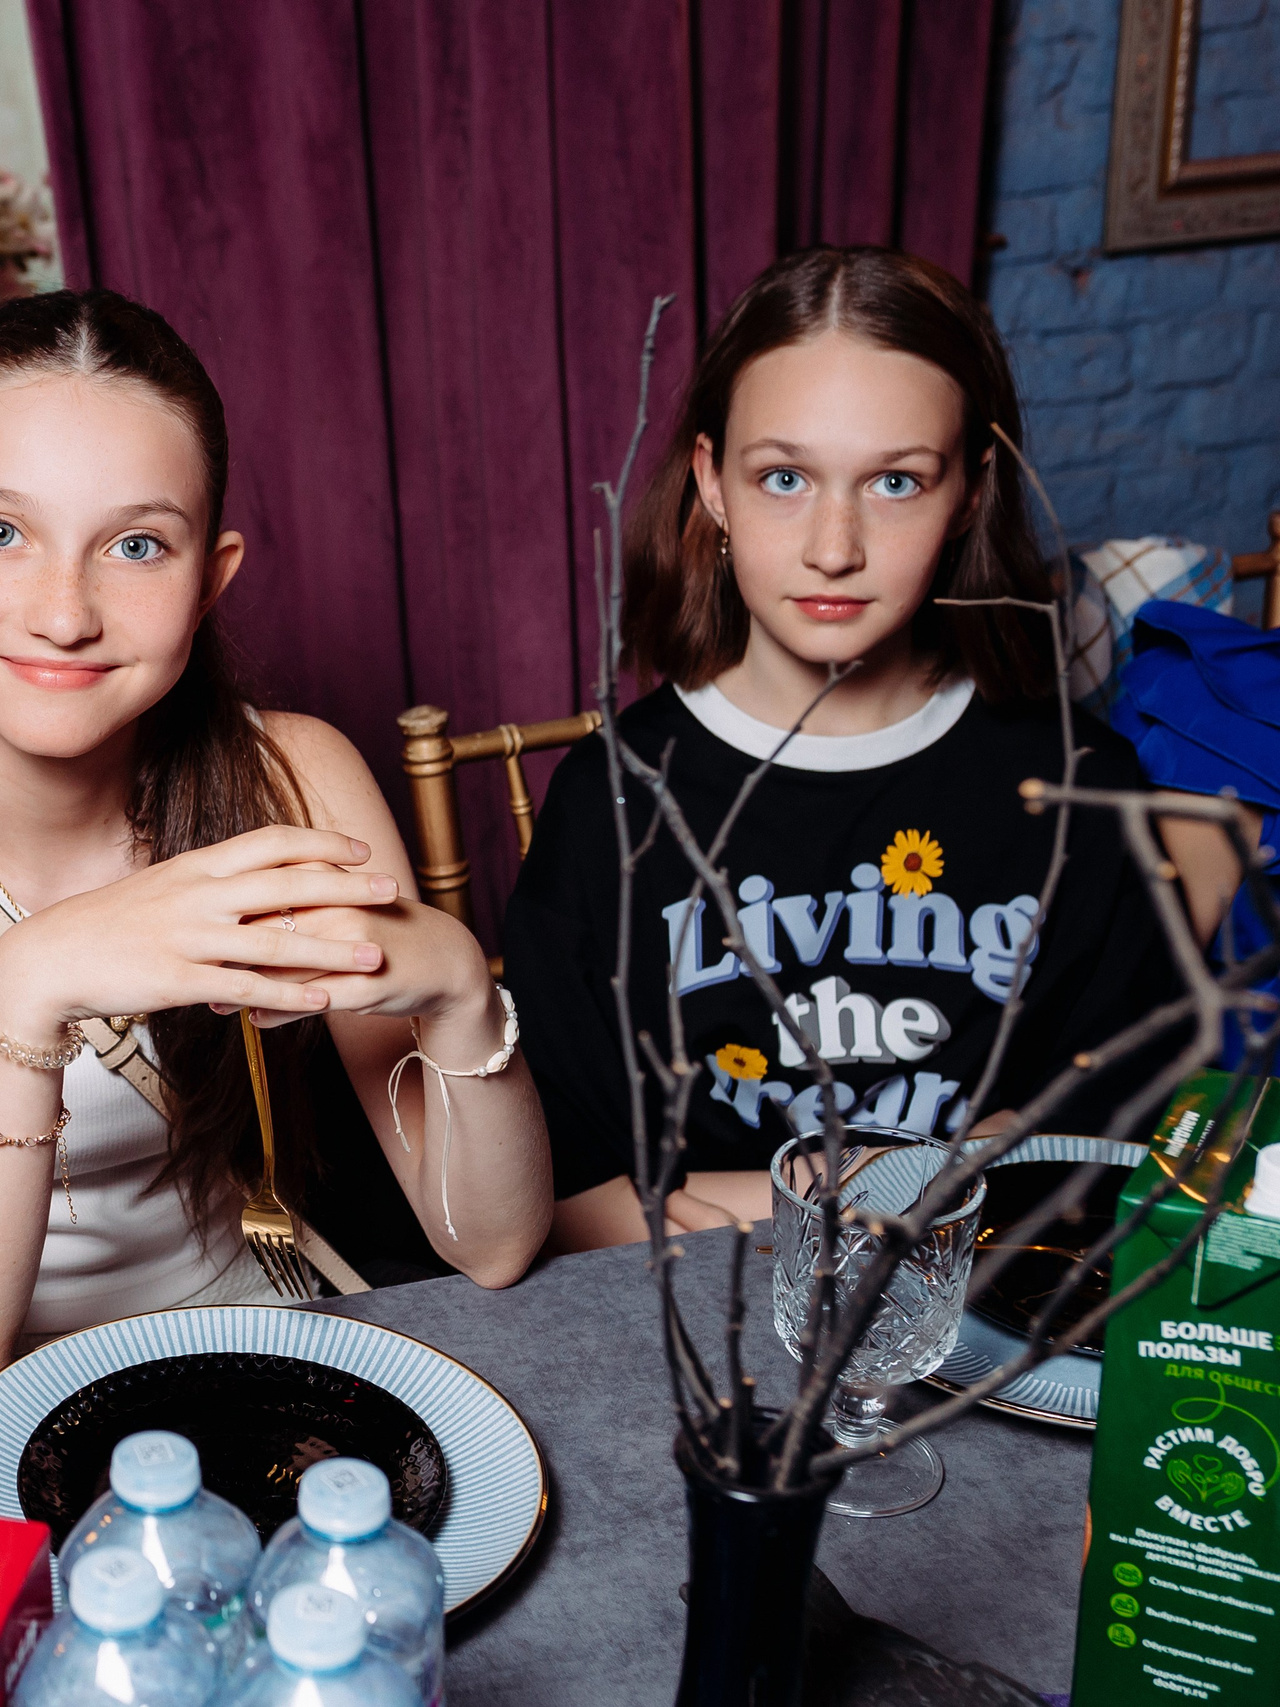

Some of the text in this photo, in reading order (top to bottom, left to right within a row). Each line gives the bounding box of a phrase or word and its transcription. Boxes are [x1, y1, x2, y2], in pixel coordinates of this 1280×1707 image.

[662, 862, 1046, 1003] Living
[772, 976, 951, 1069] the
[1138, 1340, 1241, 1367] ПОЛЬЗЫ
[1160, 1321, 1274, 1351] БОЛЬШЕ
[1164, 1363, 1205, 1381] ДЛЯ
[1143, 1426, 1267, 1497] РАСТИМ ДОБРО
[1154, 1494, 1252, 1533] ВМЕСТЕ
